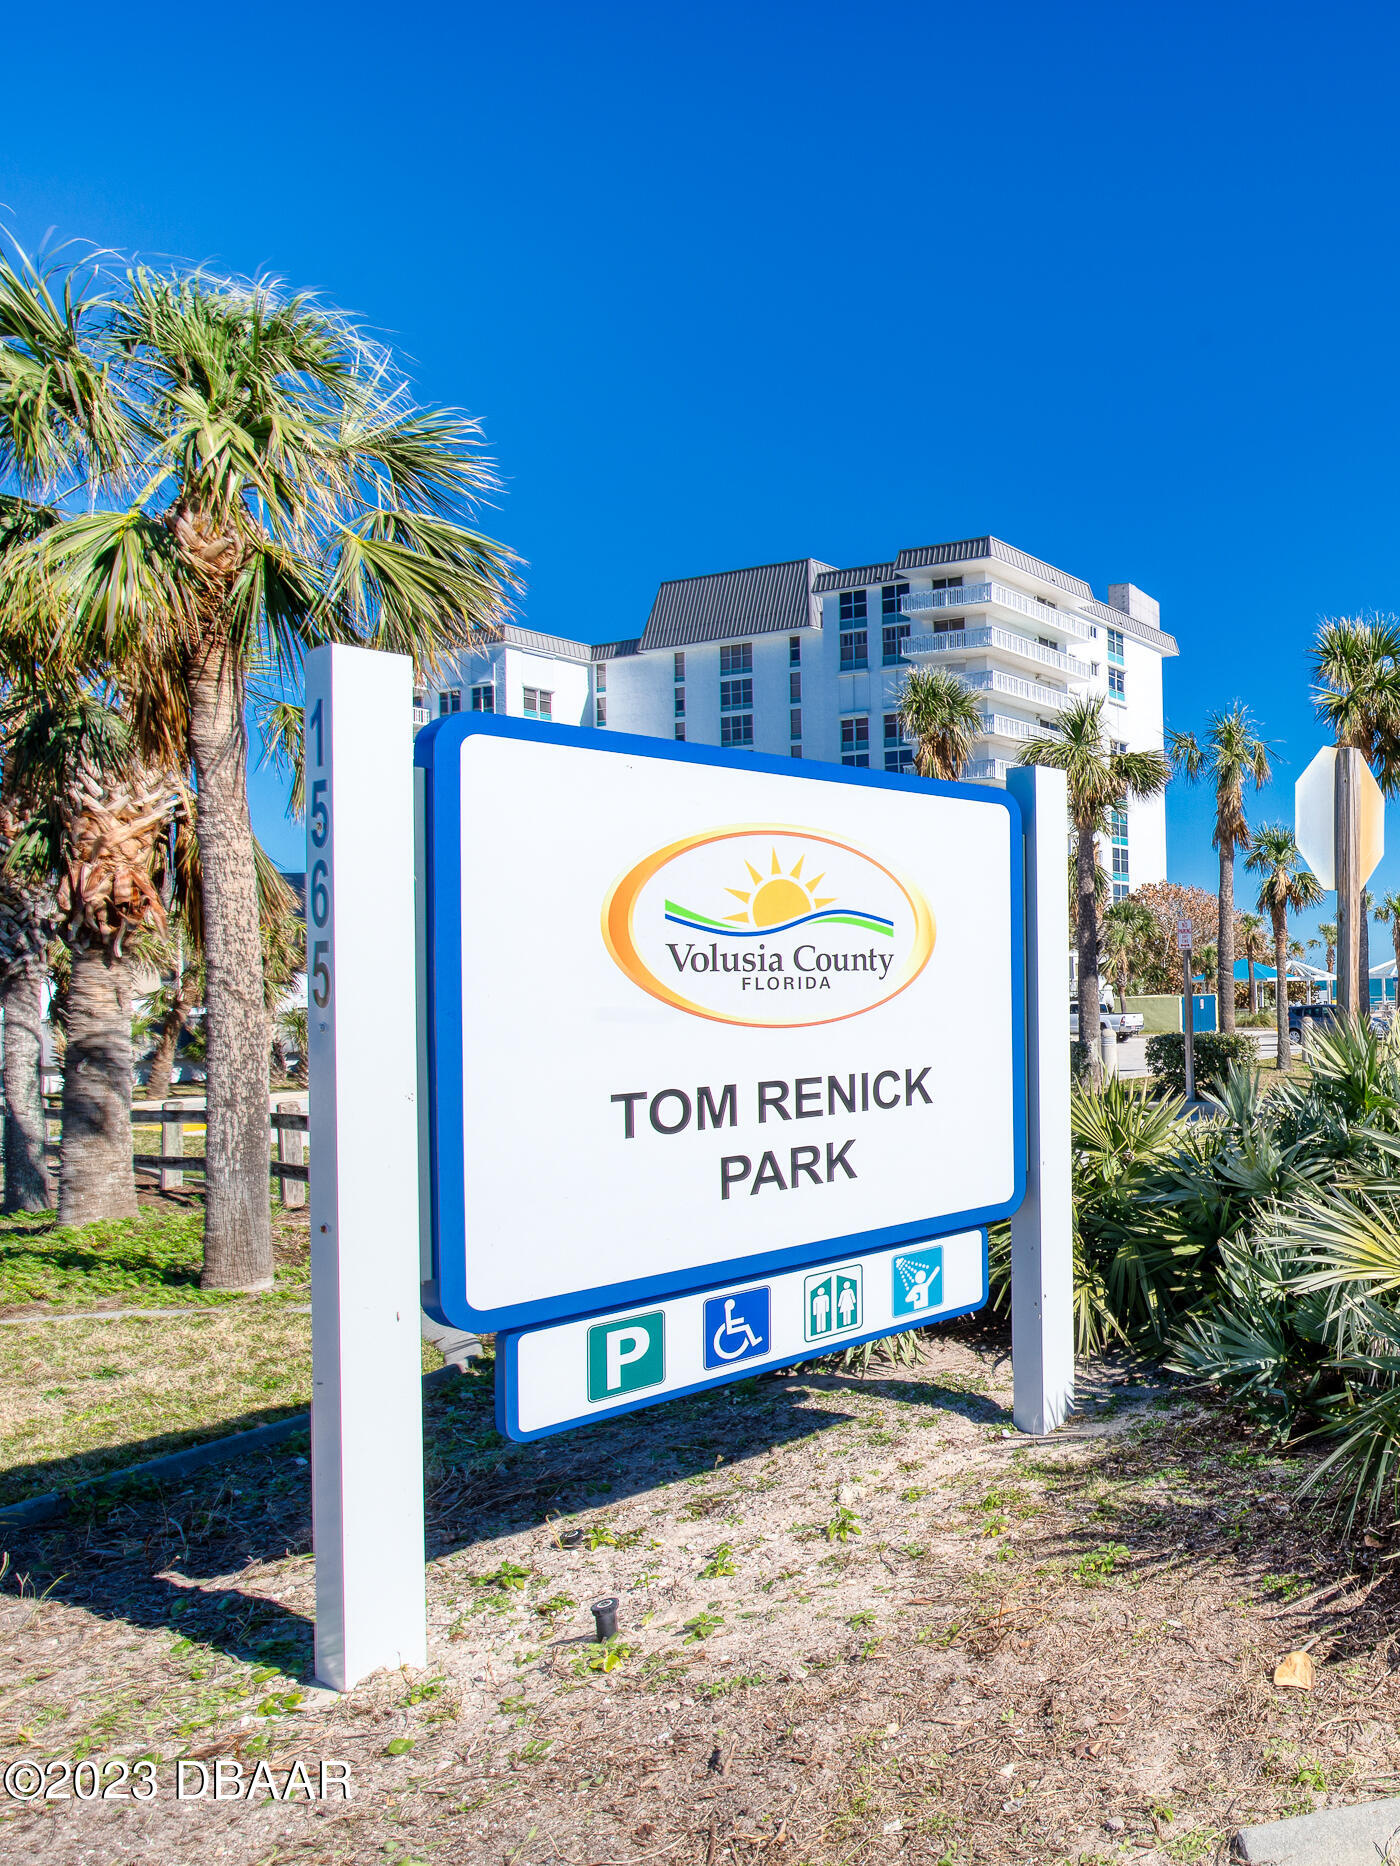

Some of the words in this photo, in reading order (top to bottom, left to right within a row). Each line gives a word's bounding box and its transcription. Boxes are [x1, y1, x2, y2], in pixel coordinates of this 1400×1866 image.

[310, 698, 331, 1008] 1565
[665, 943, 785, 974] Volusia
[793, 945, 894, 980] County
[741, 976, 832, 991] FLORIDA
[610, 1084, 739, 1139] TOM
[757, 1066, 934, 1125] RENICK
[720, 1139, 858, 1201] PARK
[606, 1325, 651, 1391] P
